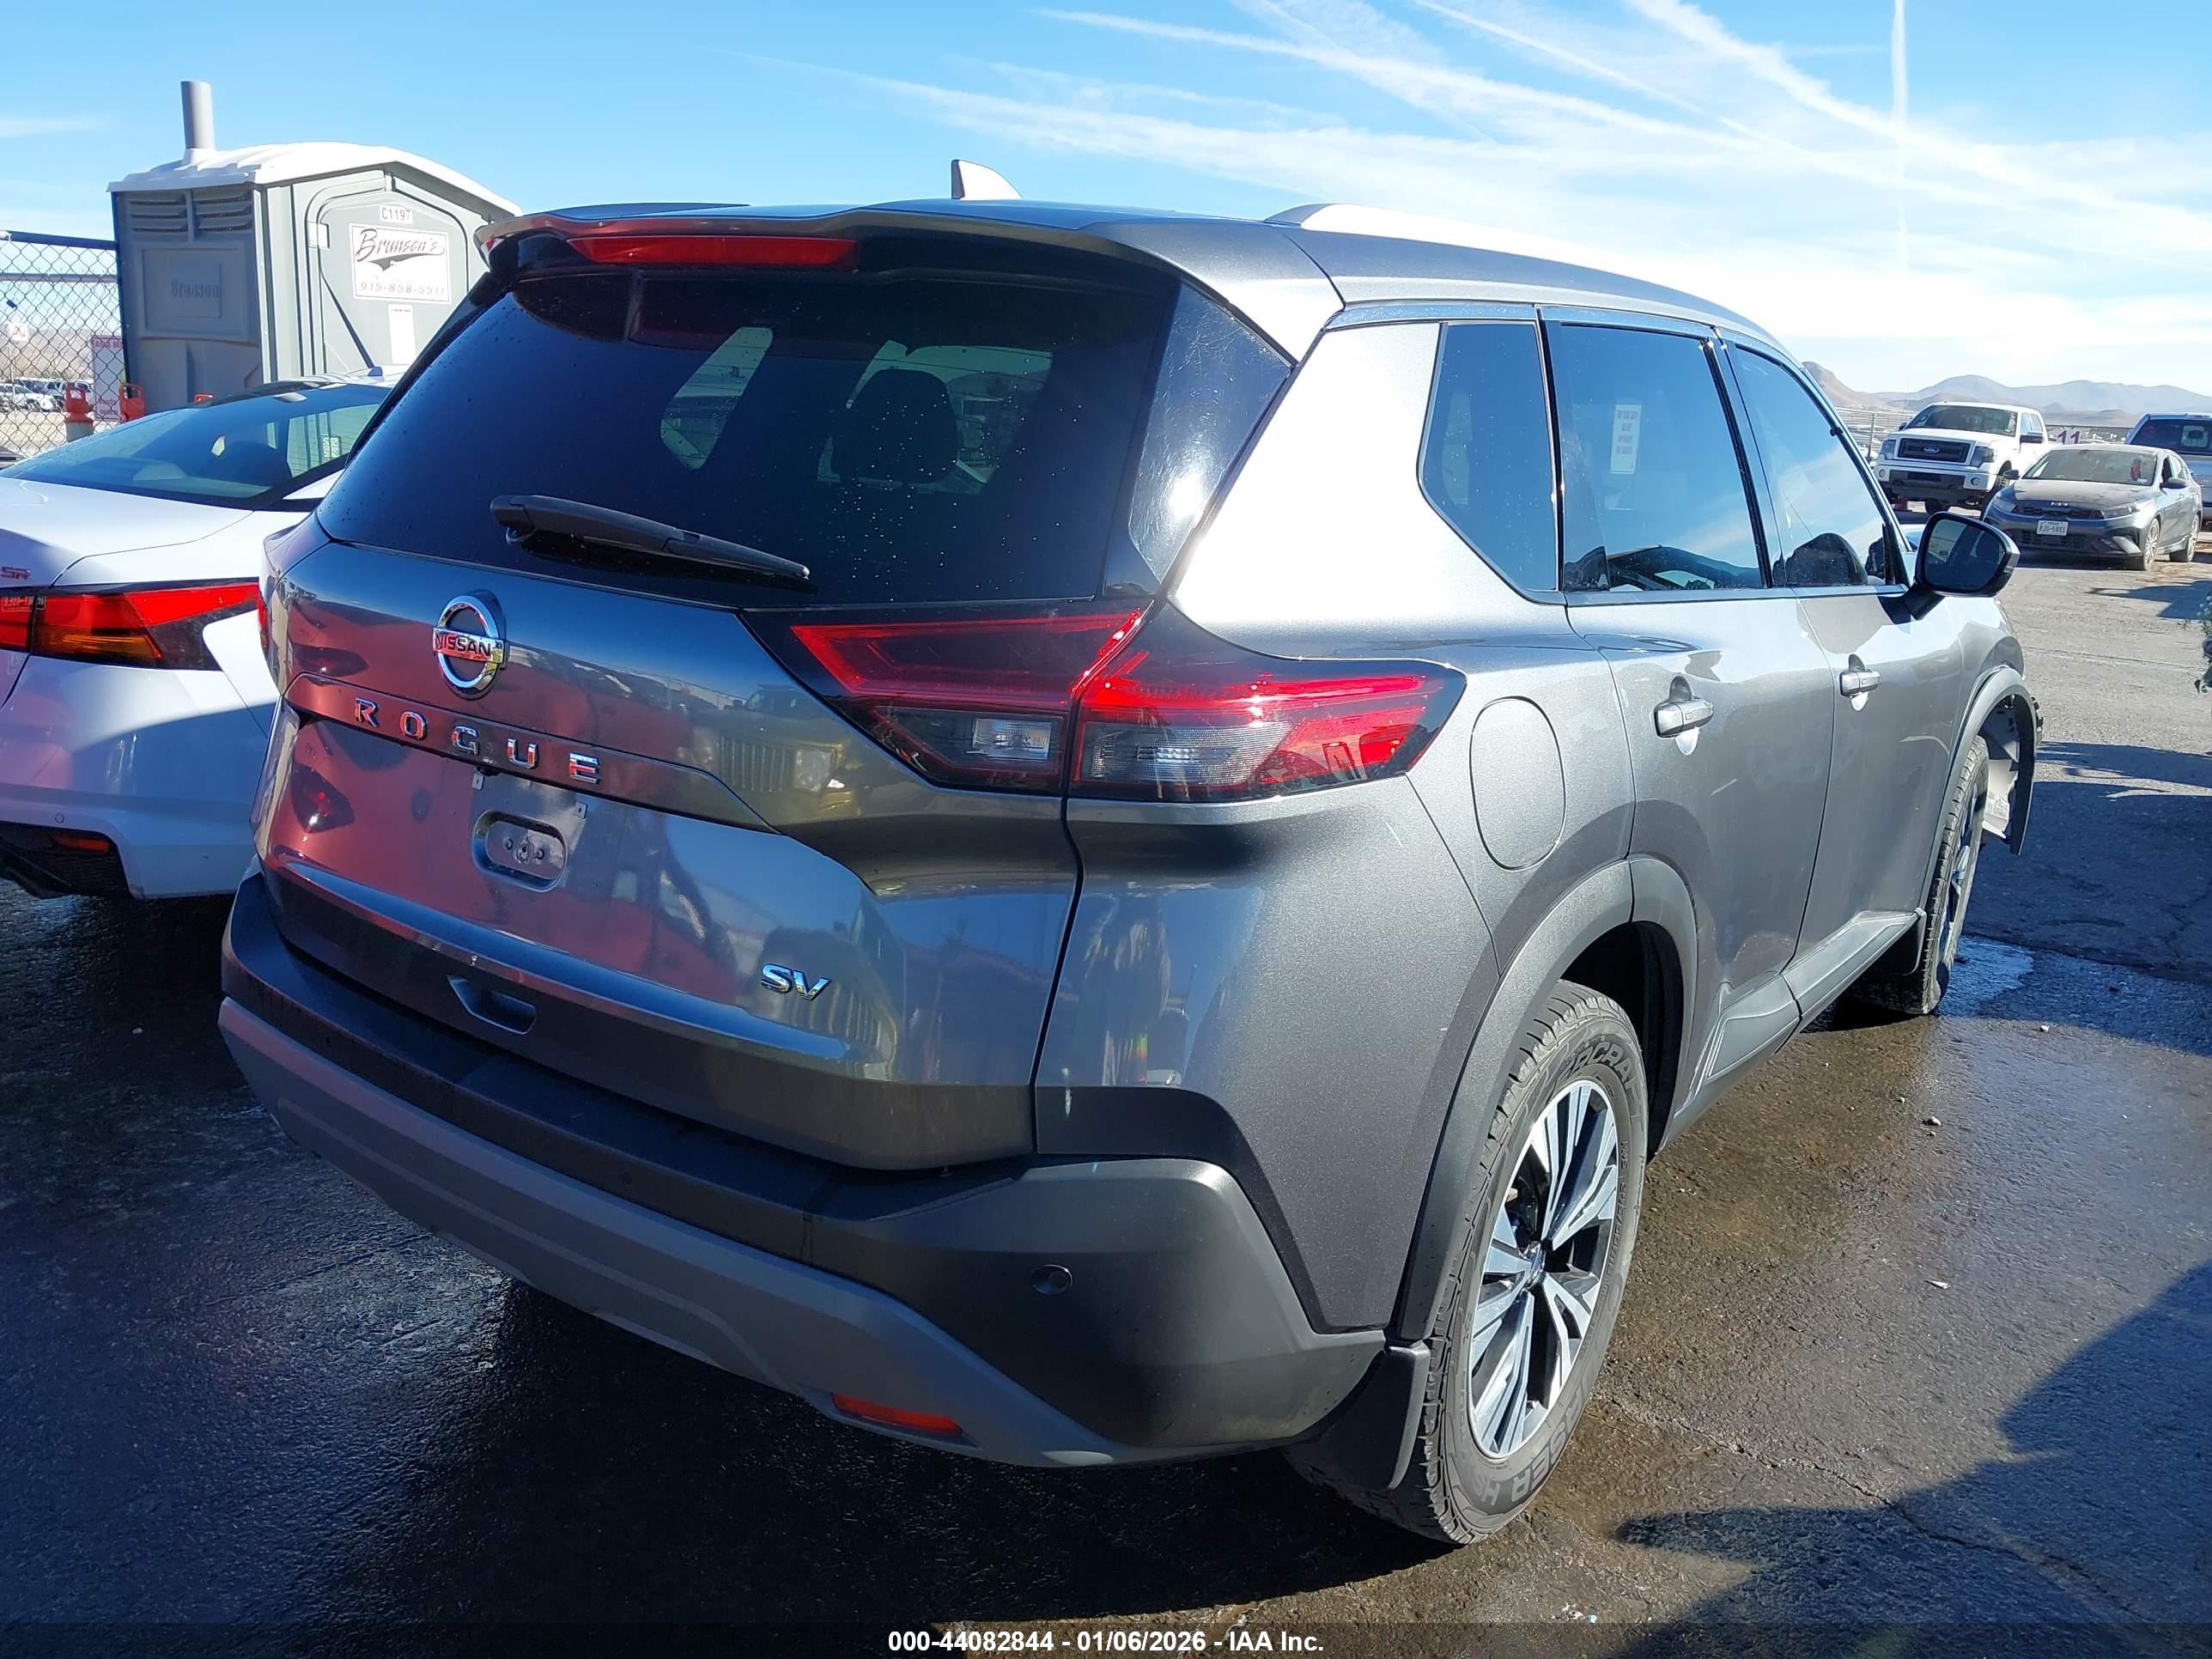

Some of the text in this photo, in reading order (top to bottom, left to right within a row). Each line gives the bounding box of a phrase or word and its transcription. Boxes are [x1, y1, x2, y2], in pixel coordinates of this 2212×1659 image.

[381, 207, 411, 222] C1197
[355, 228, 440, 263] Brunson's
[434, 631, 492, 657] NISSAN
[354, 697, 601, 784] ROGUE
[761, 963, 833, 1001] SV
